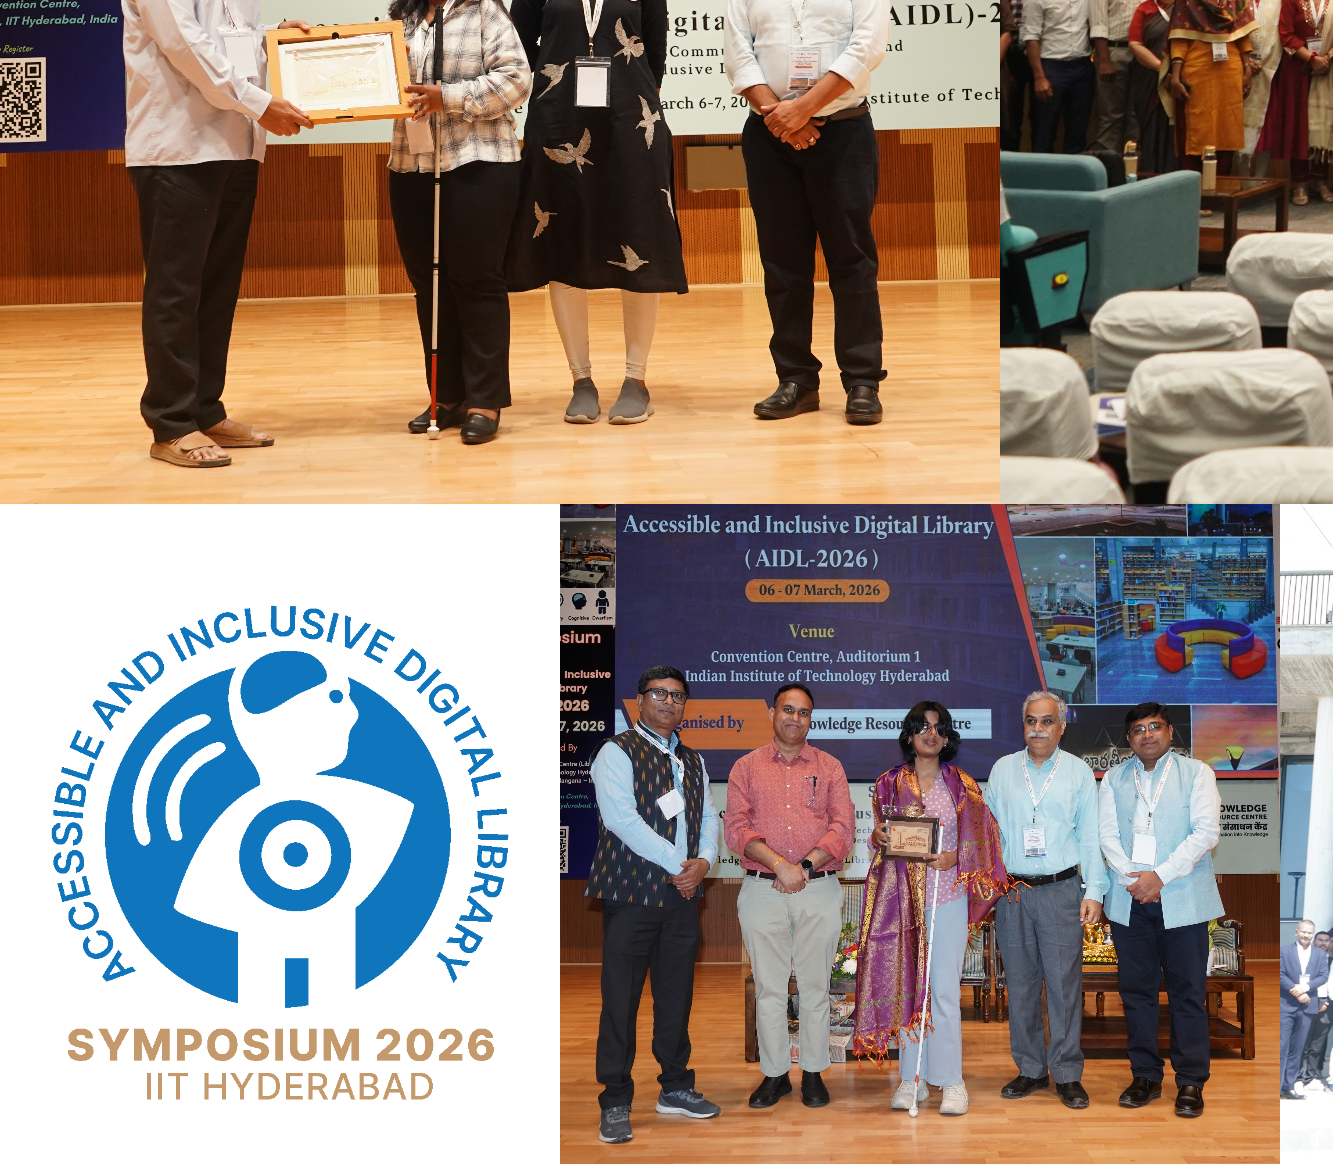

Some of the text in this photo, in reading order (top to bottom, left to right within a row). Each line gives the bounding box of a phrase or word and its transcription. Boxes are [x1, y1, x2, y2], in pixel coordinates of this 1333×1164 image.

[40, 0, 80, 9] Centre,
[6, 14, 118, 27] IIT Hyderabad, India
[623, 514, 994, 539] Accessible and Inclusive Digital Library
[785, 584, 880, 597] 07 March, 2026
[789, 624, 834, 638] Venue
[711, 650, 910, 664] Convention Centre, Auditorium
[565, 670, 611, 678] Inclusive
[685, 670, 950, 686] Indian Institute of Technology Hyderabad
[52, 605, 508, 983] ACCESSIBLE AND INCLUSIVE DIGITAL LIBRARY
[68, 1029, 494, 1061] SYMPOSIUM 2026
[147, 1073, 433, 1100] IIT HYDERABAD
